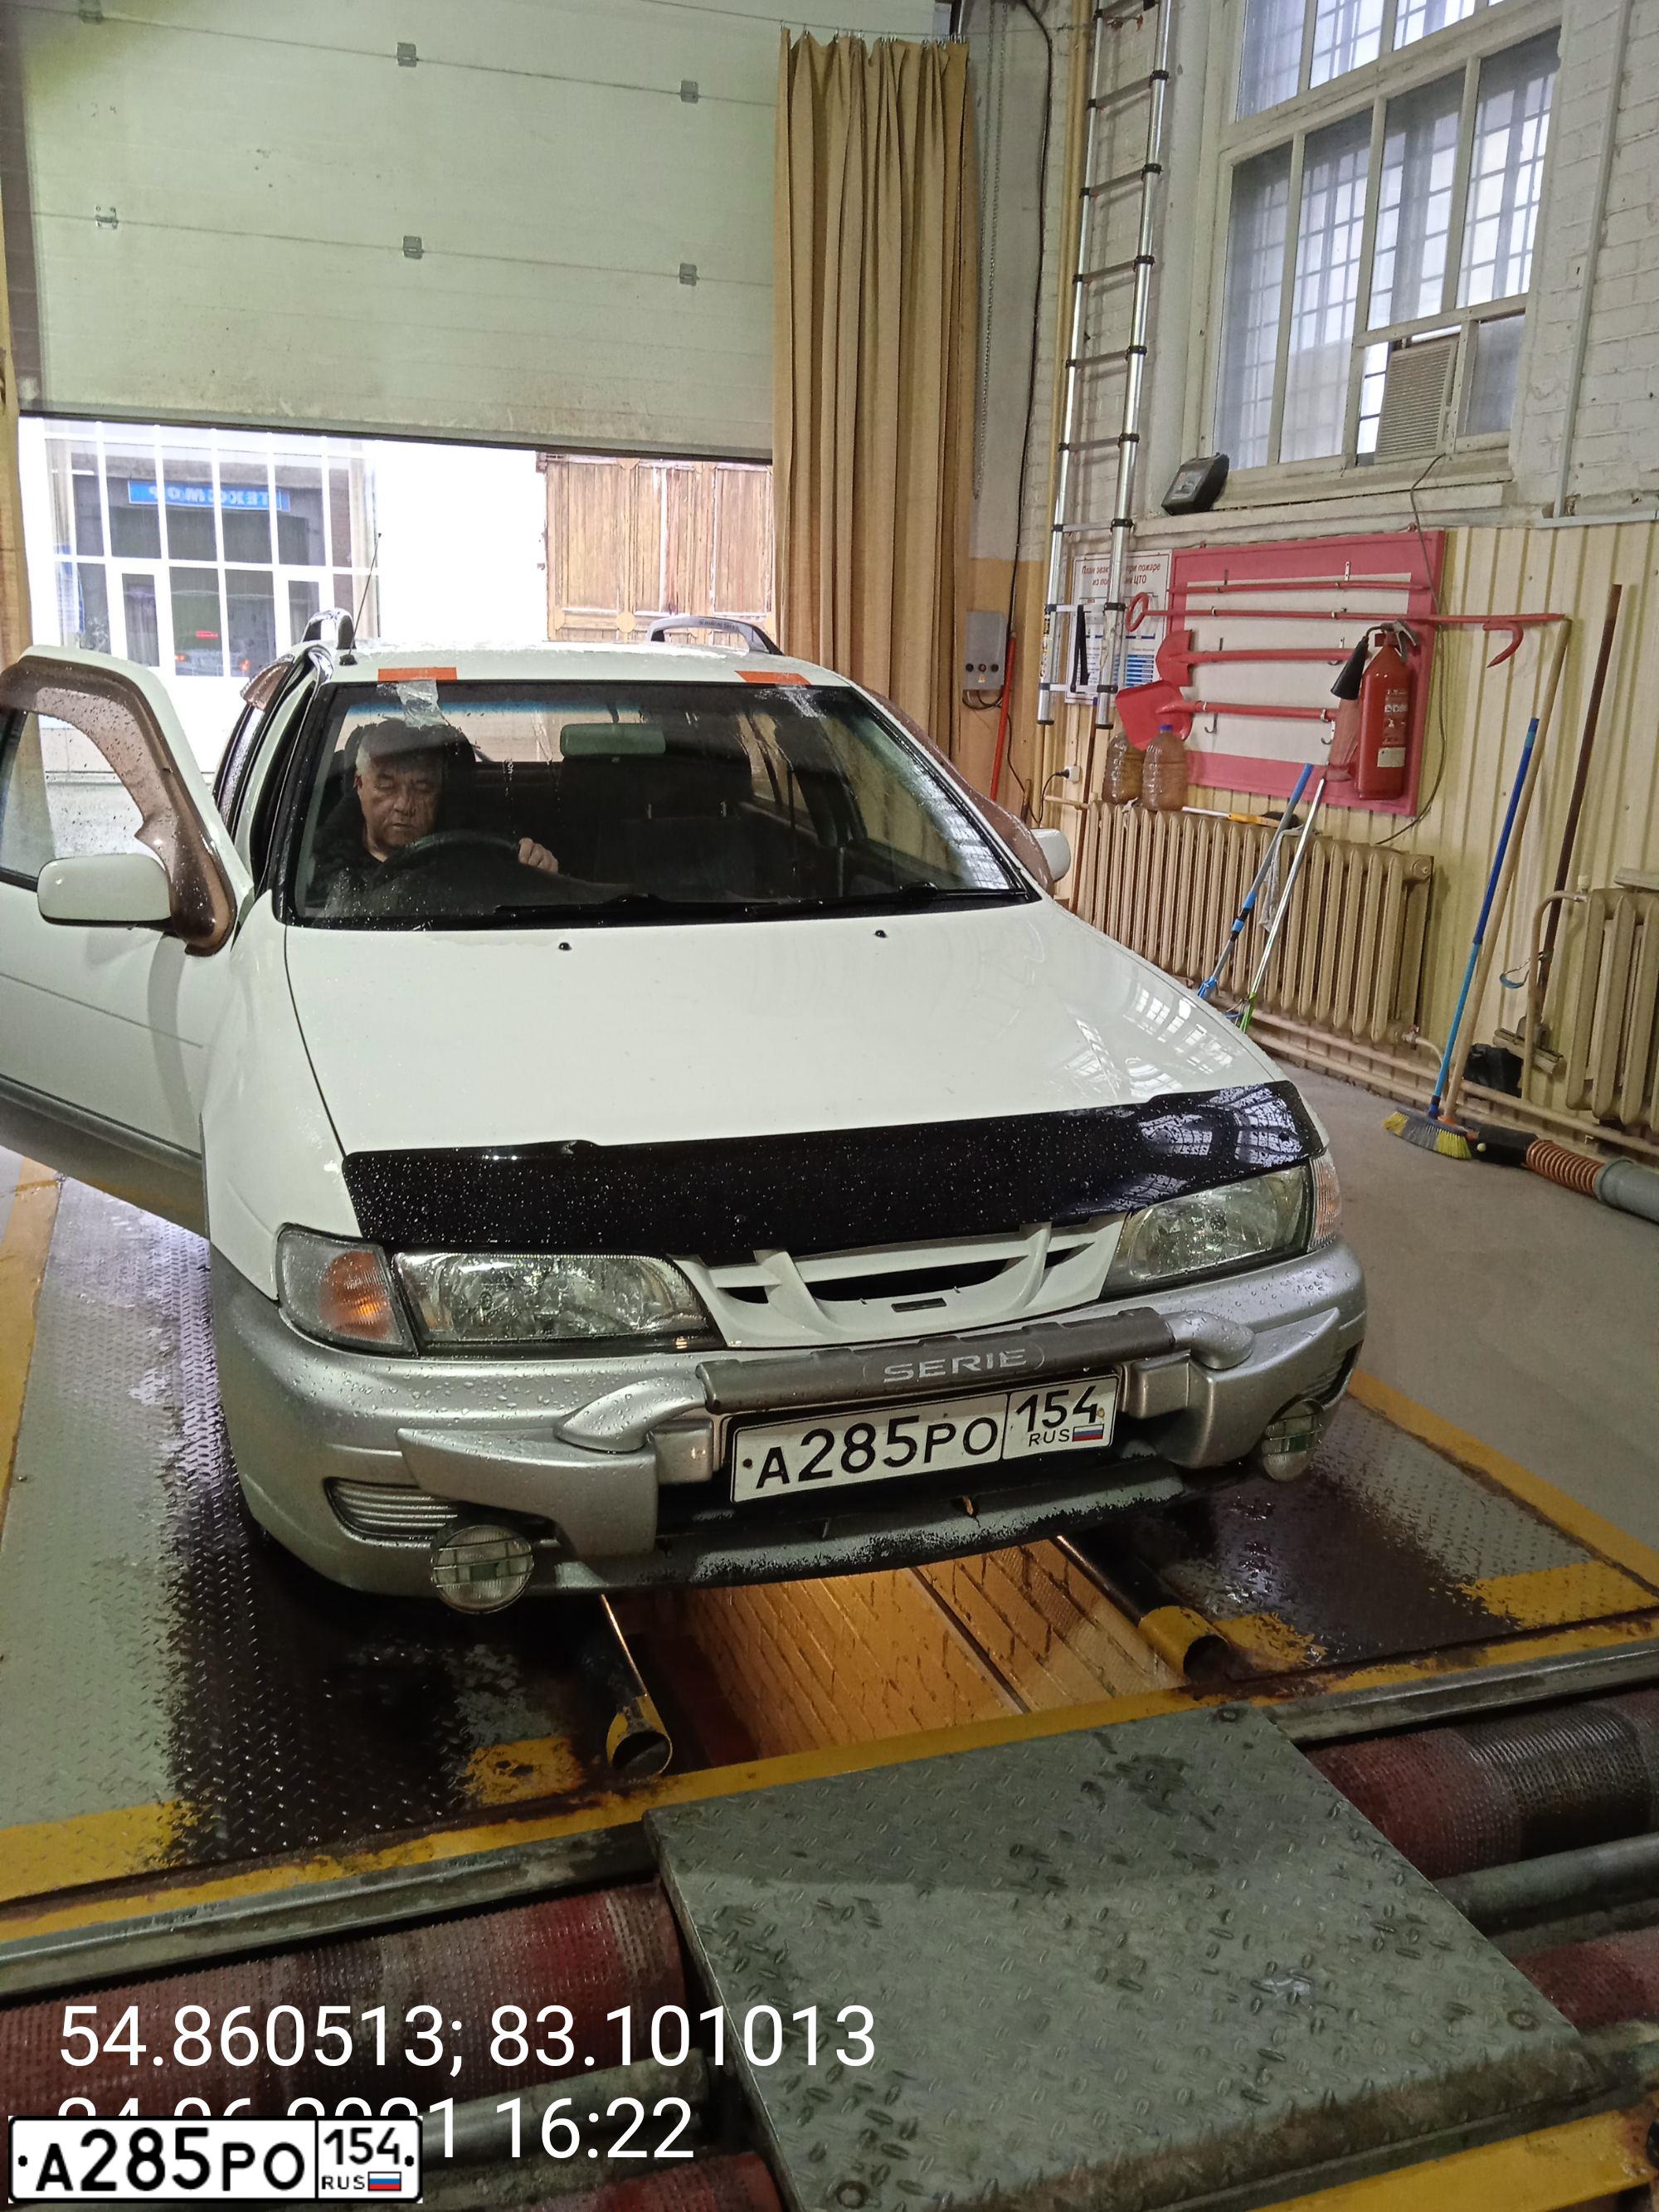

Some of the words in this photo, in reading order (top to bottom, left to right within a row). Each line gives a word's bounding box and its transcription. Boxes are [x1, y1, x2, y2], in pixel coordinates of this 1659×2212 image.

[1137, 563, 1161, 573] пожаре
[1134, 574, 1147, 587] ЦТО
[883, 1349, 1028, 1384] SERIE
[755, 1415, 999, 1489] А285РО
[1014, 1386, 1100, 1434] 154
[1028, 1429, 1071, 1448] RUS
